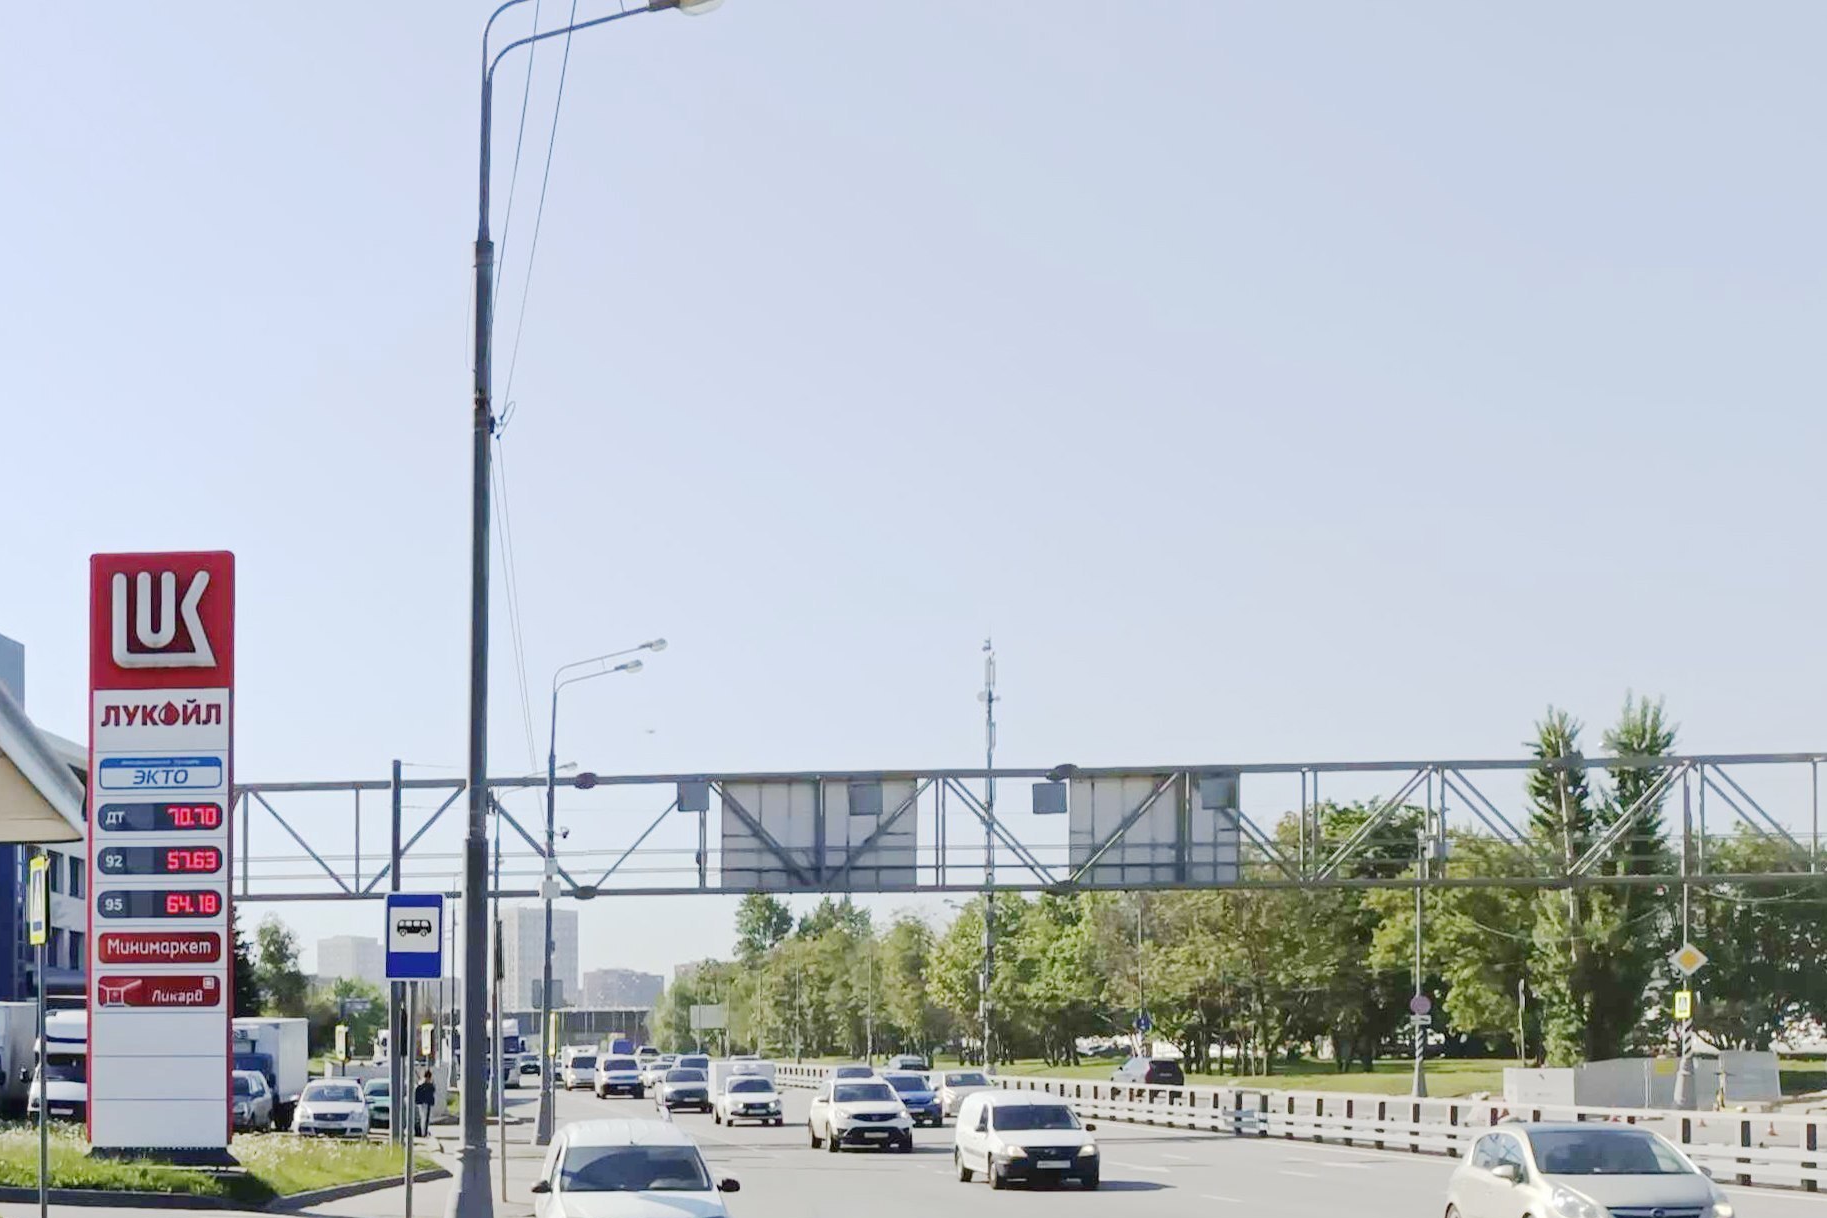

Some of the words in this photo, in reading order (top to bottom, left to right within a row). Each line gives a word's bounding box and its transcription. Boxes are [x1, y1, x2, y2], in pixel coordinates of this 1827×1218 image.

[101, 699, 221, 727] ЛУКОЙЛ
[133, 769, 188, 784] ЭКТО
[106, 811, 125, 824] ДТ
[169, 807, 216, 825] 70.70
[106, 855, 122, 867] 92
[168, 852, 216, 869] 57.63
[106, 899, 122, 910] 95
[167, 895, 216, 913] 64.18
[108, 939, 211, 958] Минимаркет
